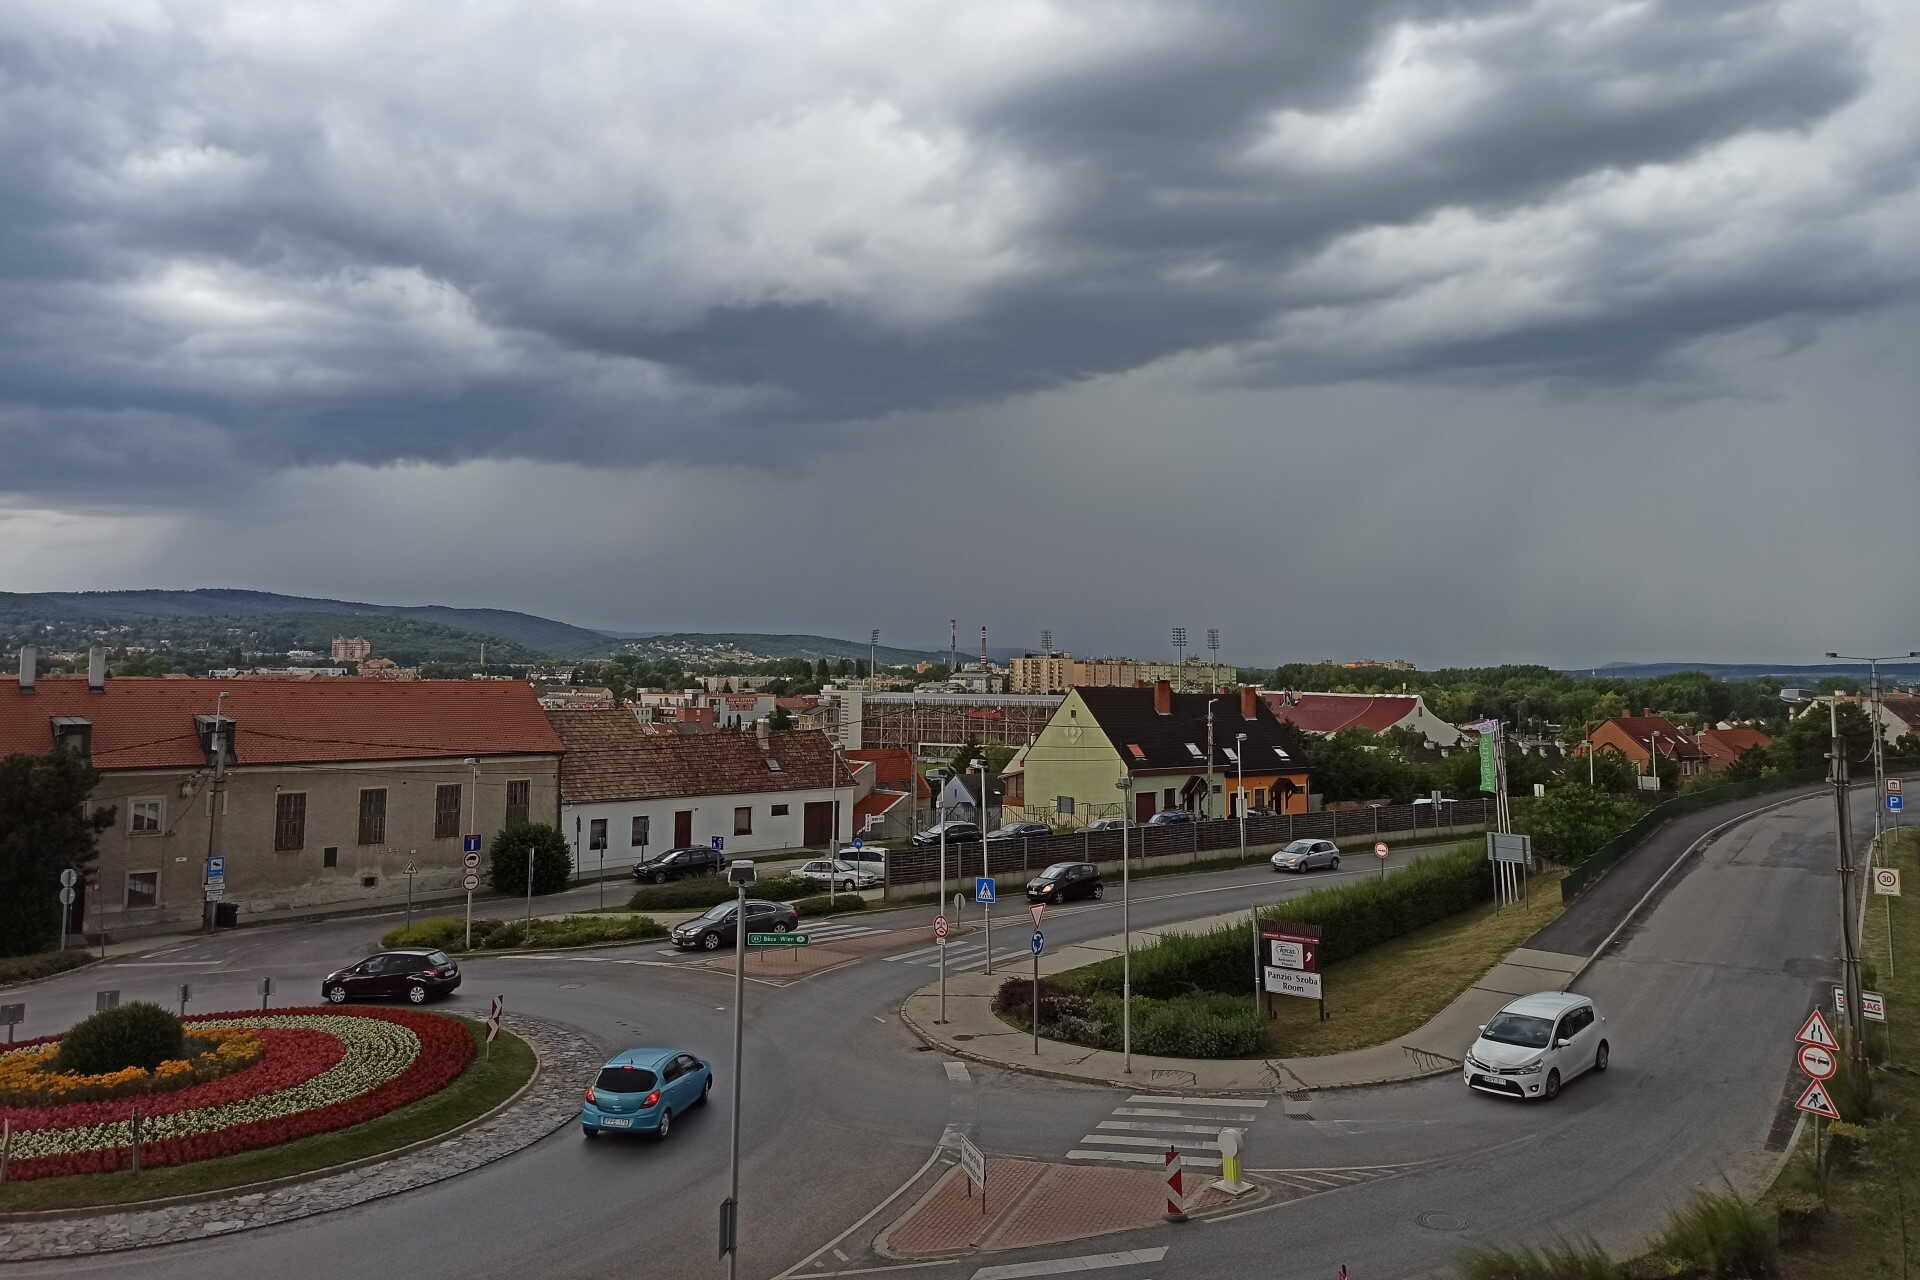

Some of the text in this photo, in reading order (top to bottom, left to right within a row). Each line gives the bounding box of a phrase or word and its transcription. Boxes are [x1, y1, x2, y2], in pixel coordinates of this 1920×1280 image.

[1890, 797, 1898, 806] P
[1882, 875, 1892, 883] 30
[1296, 974, 1318, 985] Szoba
[1283, 982, 1304, 992] Room
